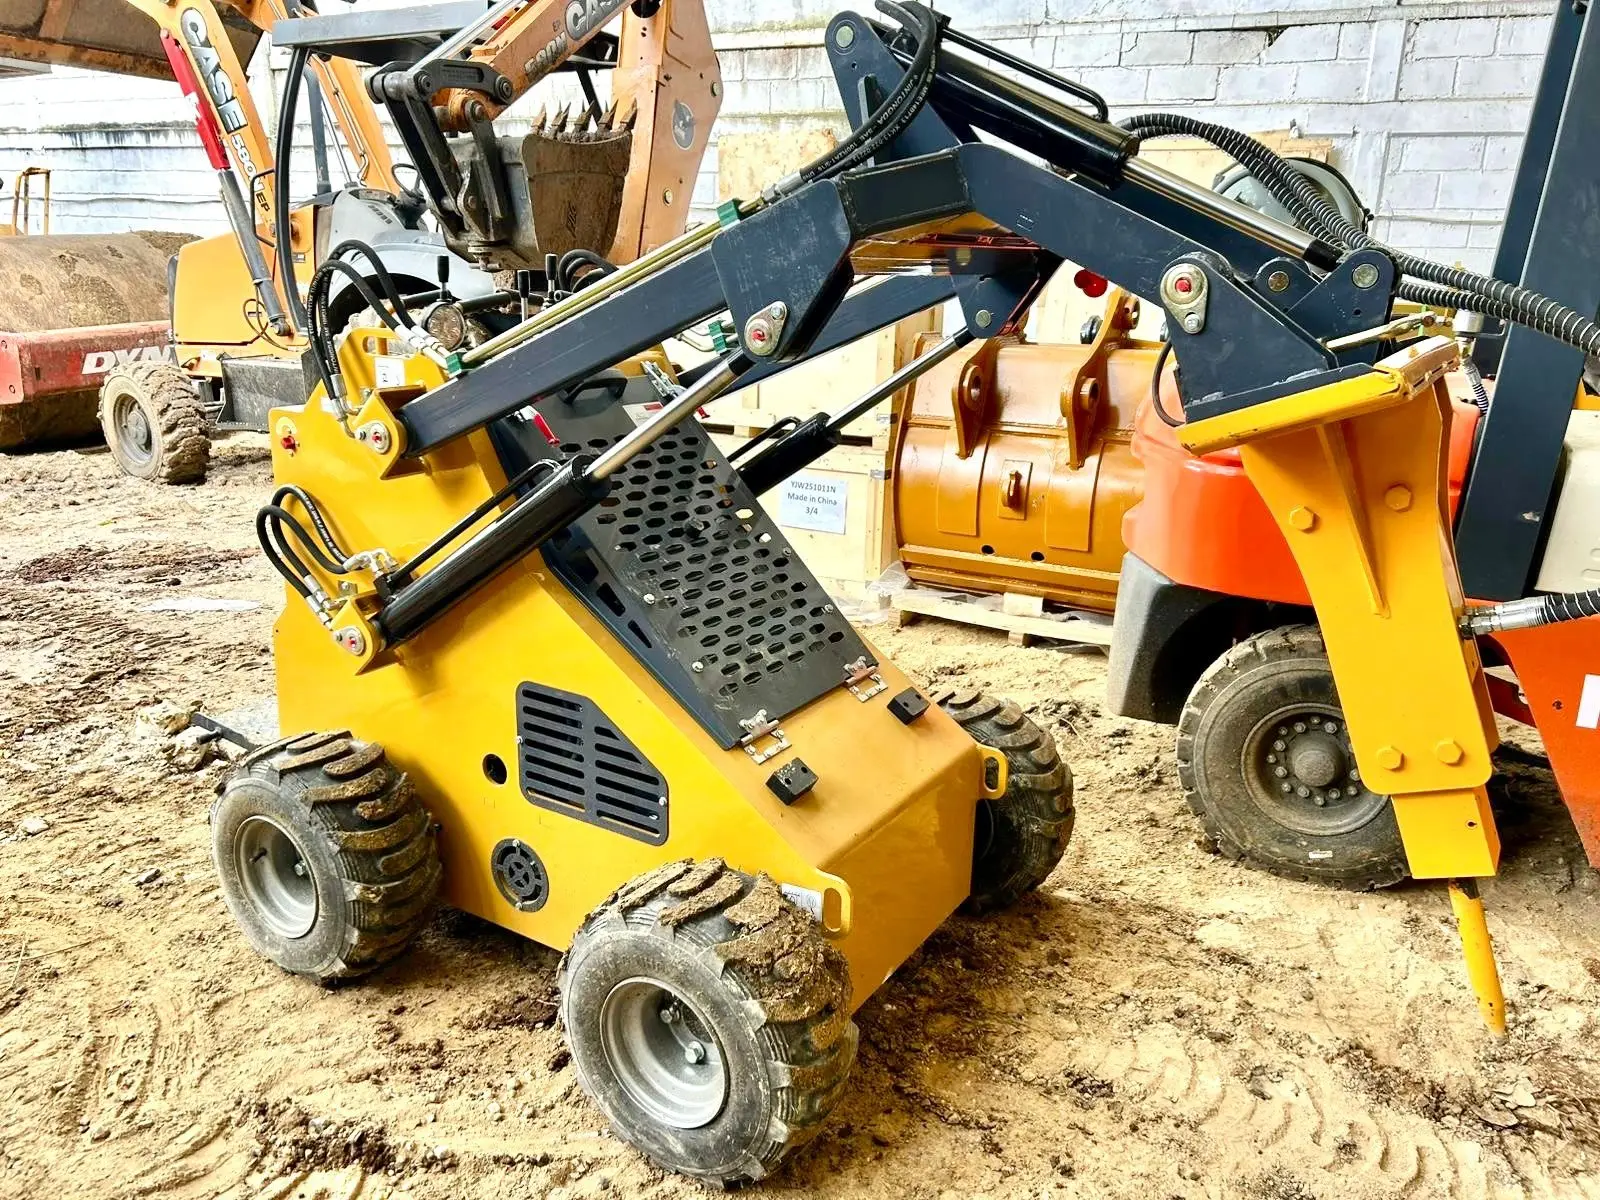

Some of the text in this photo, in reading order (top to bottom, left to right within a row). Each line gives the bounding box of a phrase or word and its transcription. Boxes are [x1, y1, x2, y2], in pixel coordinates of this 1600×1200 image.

[180, 7, 248, 134] CASE
[256, 192, 270, 212] EP
[791, 481, 836, 493] YJW251011N
[787, 492, 808, 502] Made
[817, 496, 837, 505] China
[805, 506, 818, 515] 3/4
